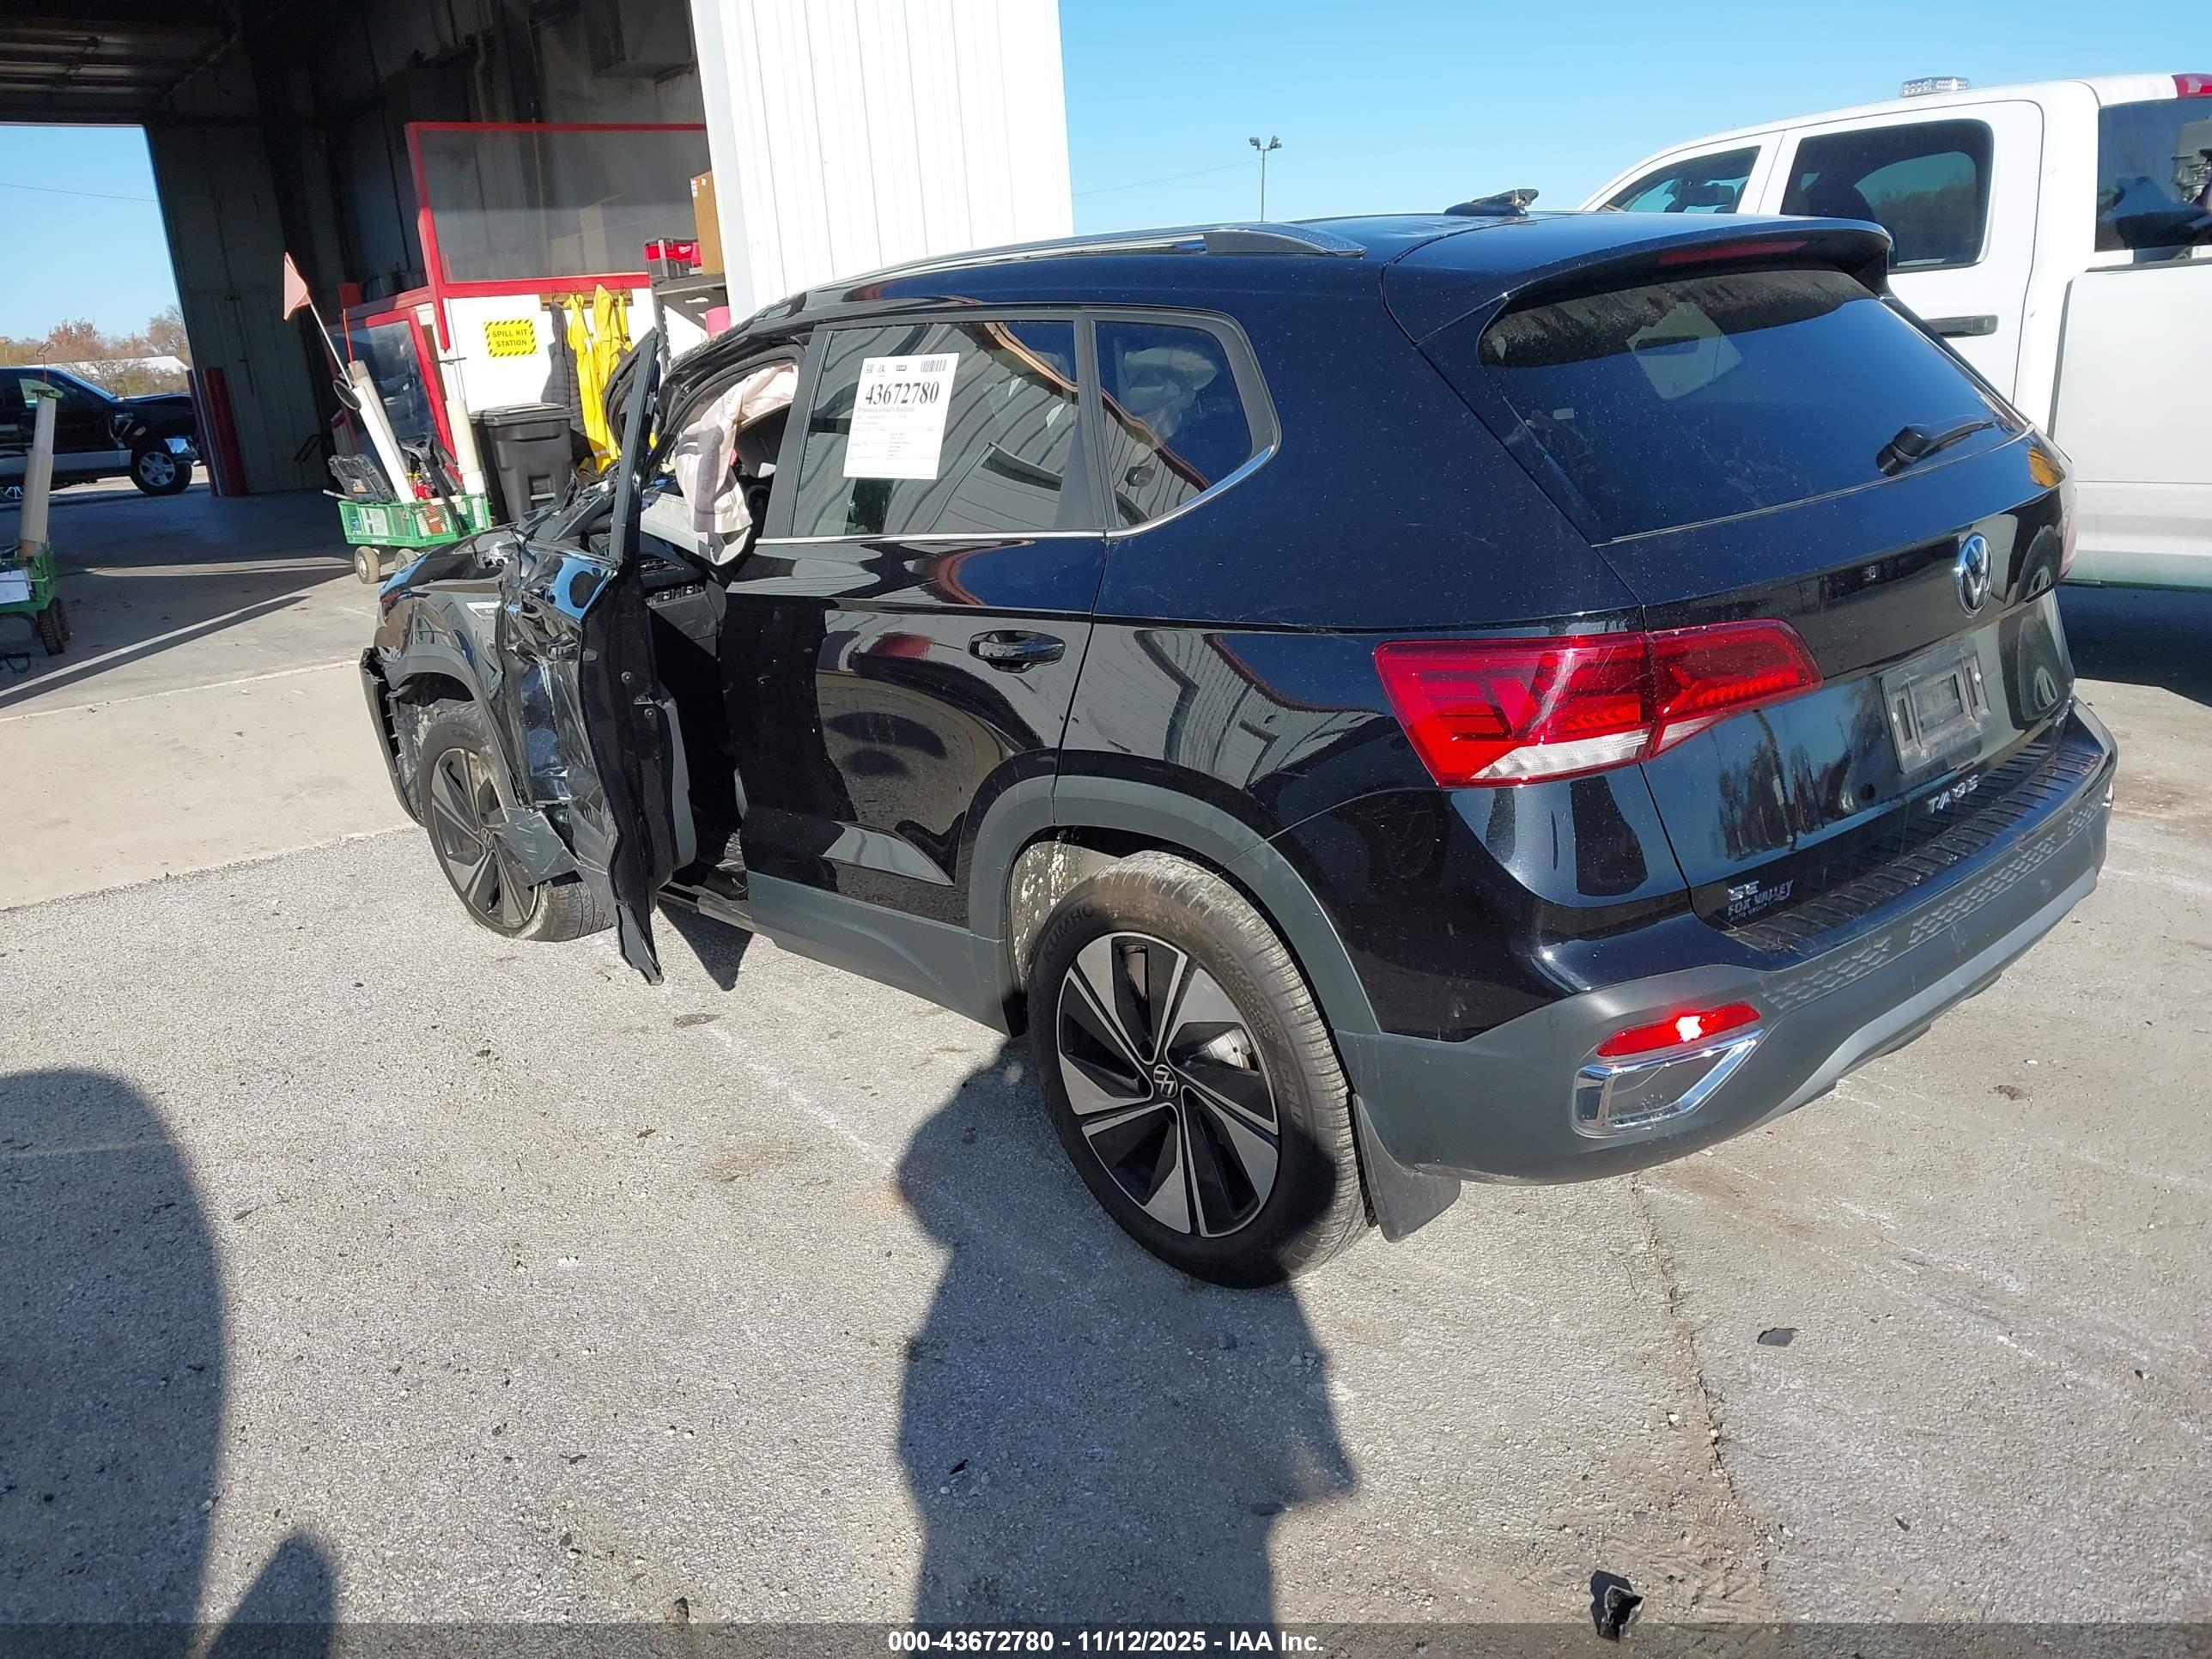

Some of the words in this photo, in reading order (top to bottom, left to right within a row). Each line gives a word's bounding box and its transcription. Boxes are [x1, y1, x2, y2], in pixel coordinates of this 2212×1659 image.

[865, 380, 940, 405] 43672780
[1926, 774, 1978, 814] TAOS
[1728, 880, 1759, 902] SE
[1728, 898, 1751, 916] FOX
[1754, 879, 1794, 906] VALLEY
[1043, 904, 1095, 961] KUMHO
